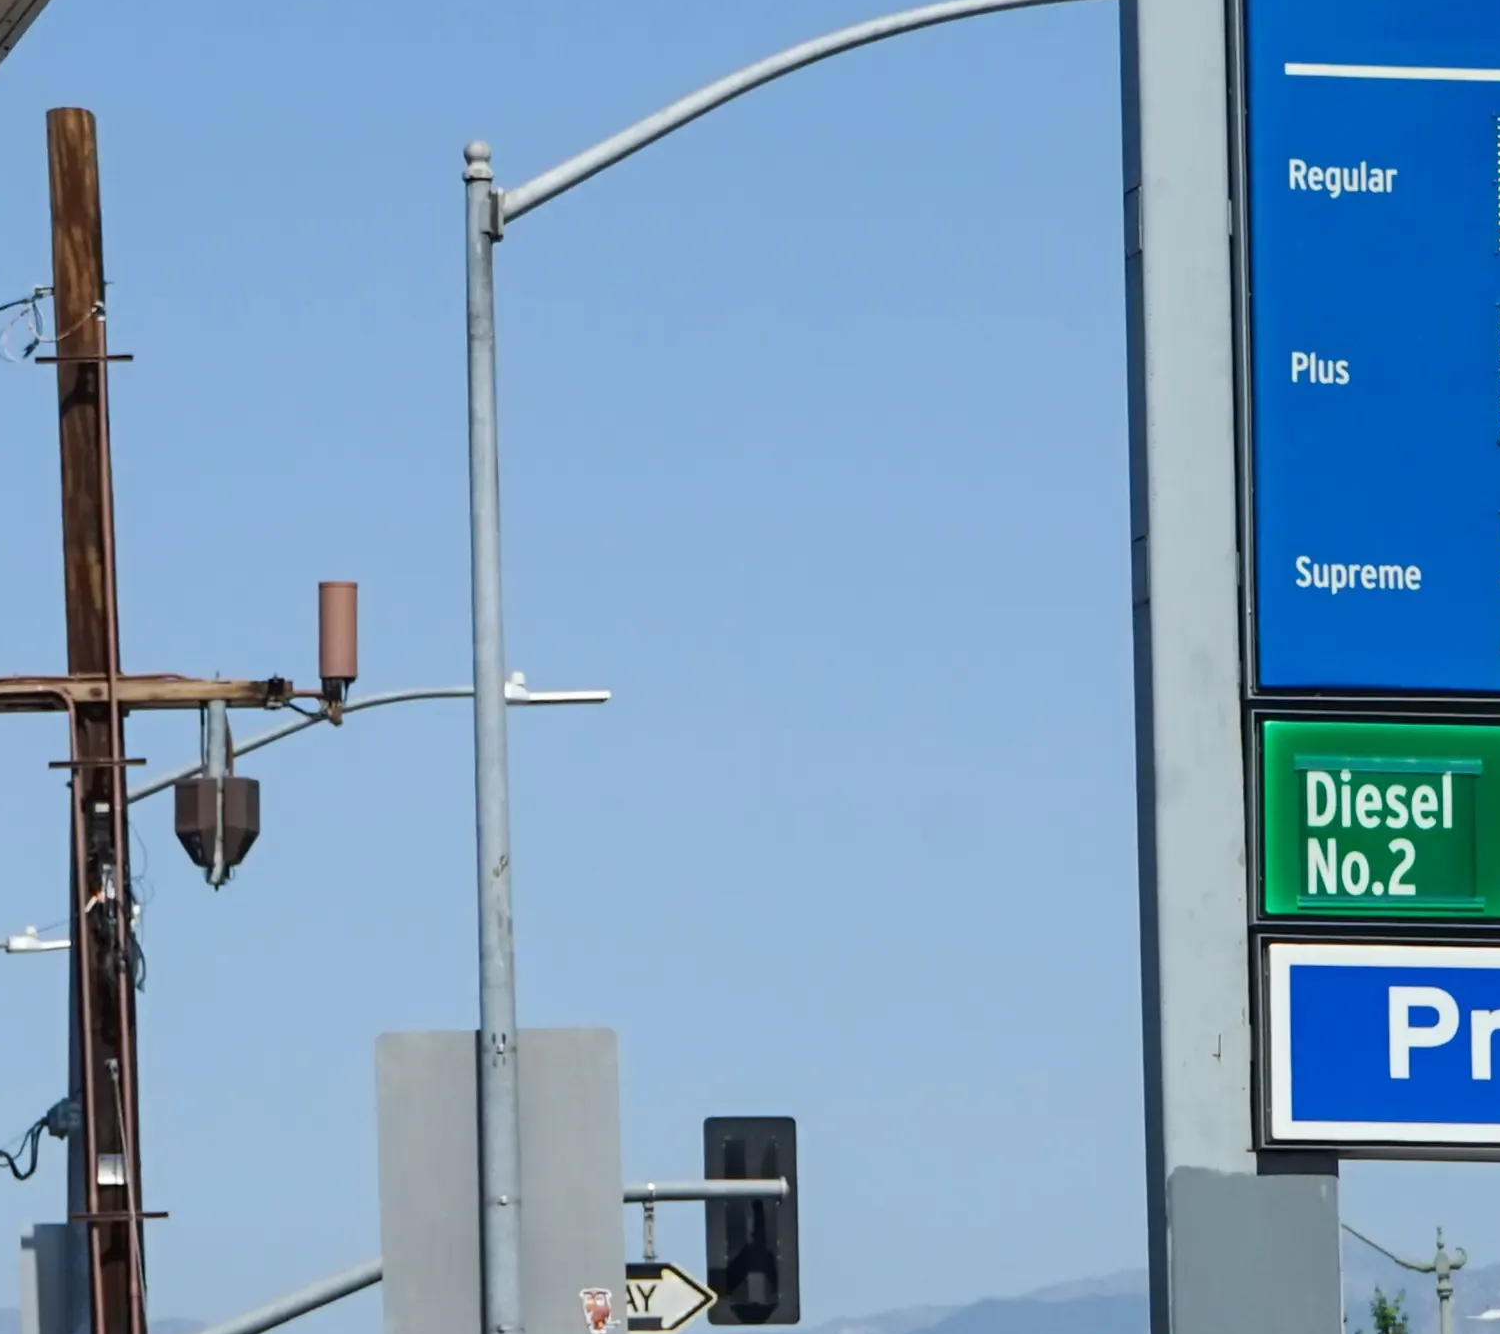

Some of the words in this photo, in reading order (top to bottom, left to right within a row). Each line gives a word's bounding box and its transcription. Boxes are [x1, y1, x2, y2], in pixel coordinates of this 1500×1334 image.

[1288, 160, 1398, 200] Regular
[1291, 353, 1351, 386] Plus
[1295, 556, 1422, 594] Supreme
[1306, 770, 1453, 830] Diesel
[1307, 838, 1418, 897] No.2
